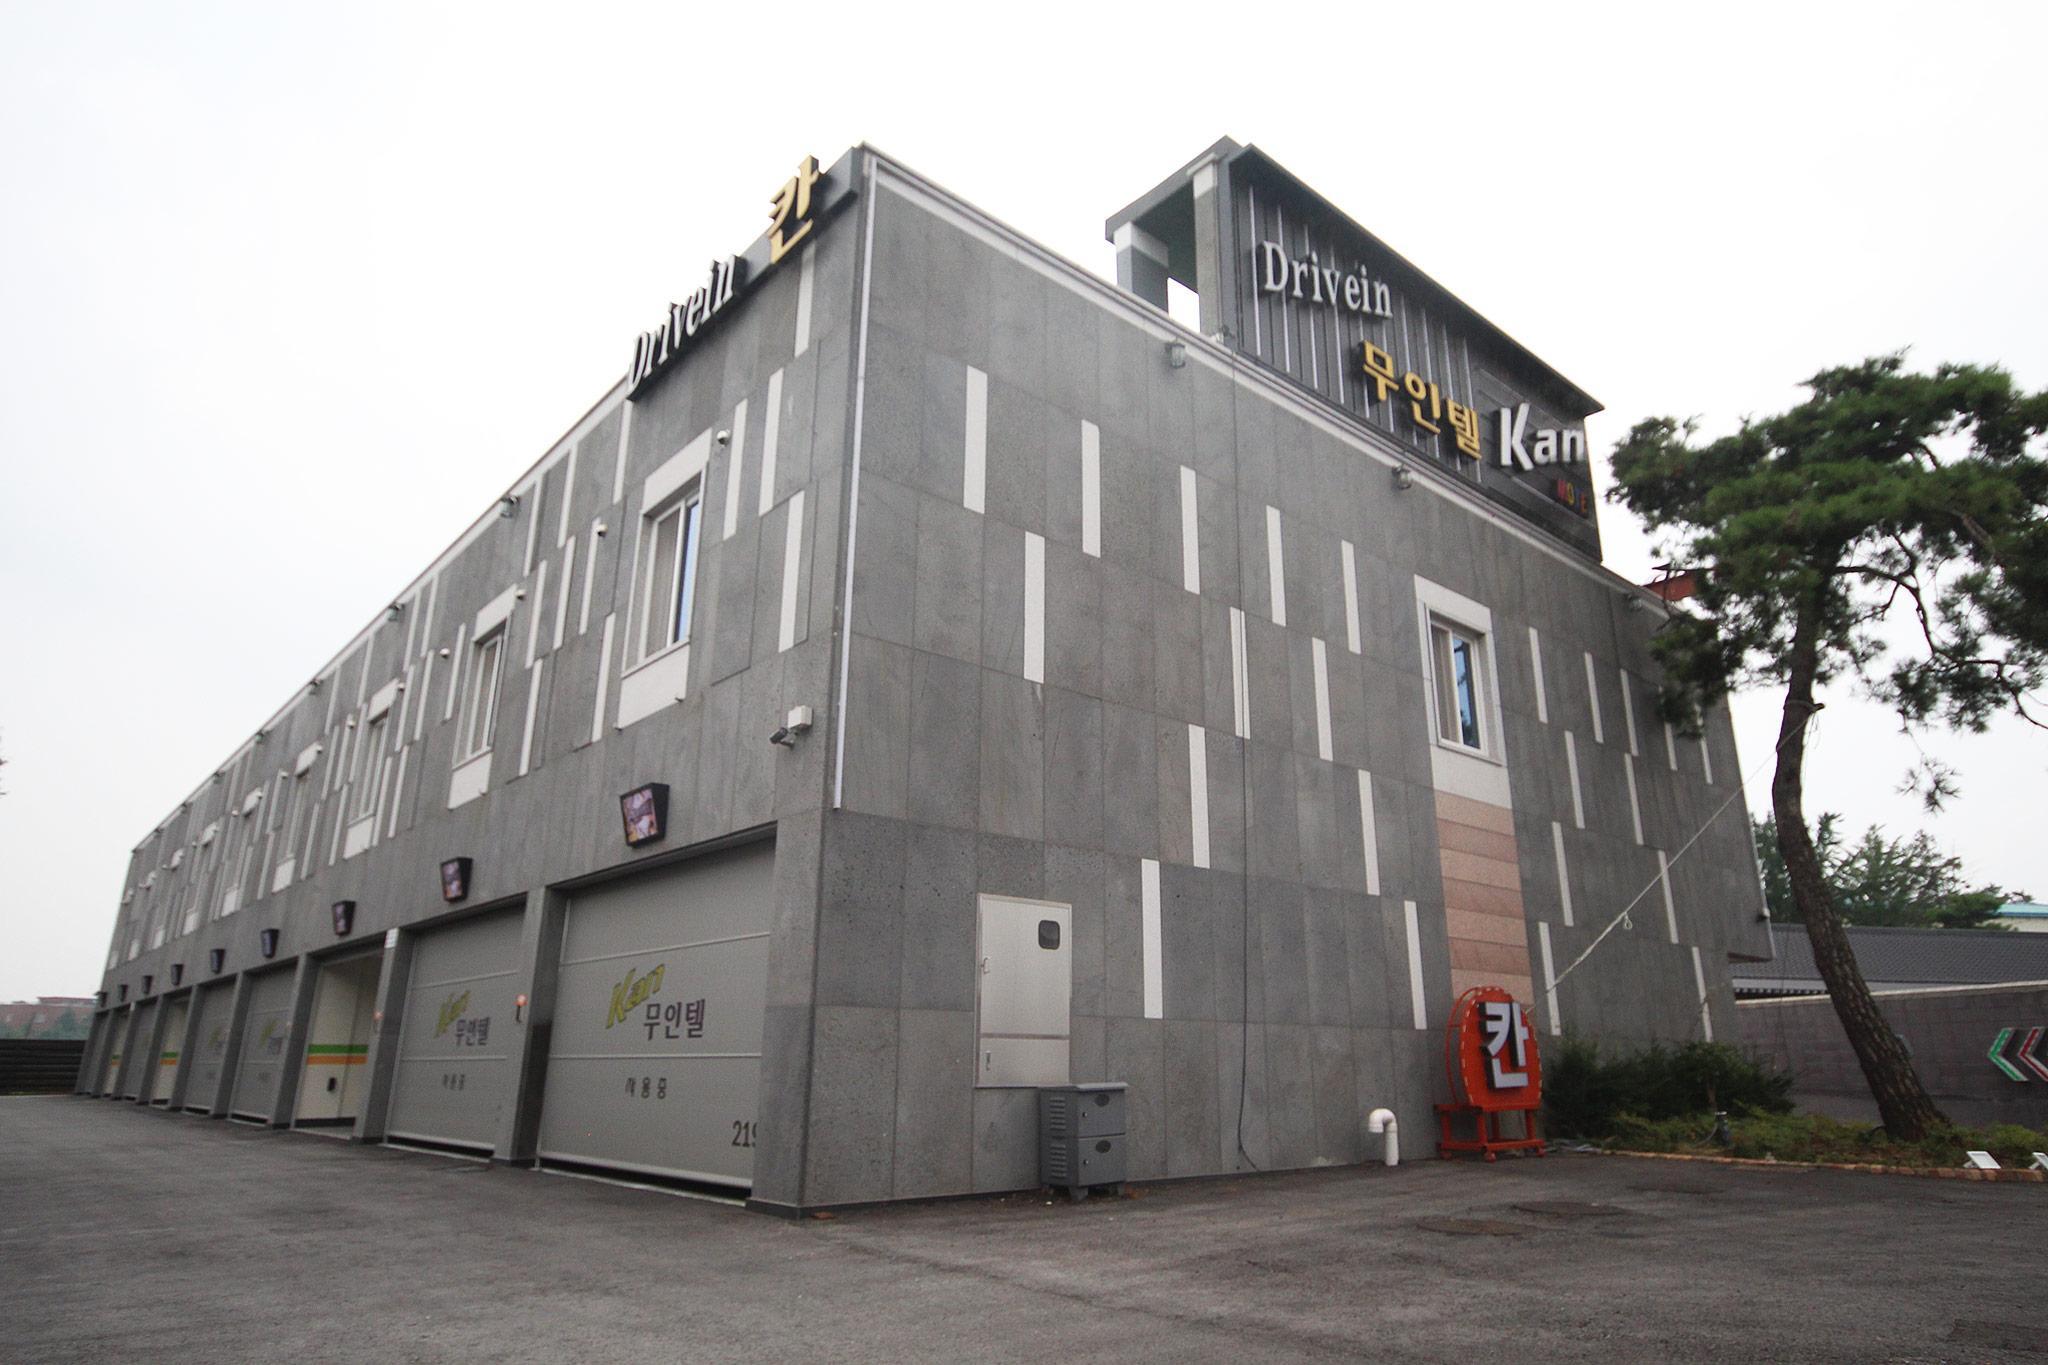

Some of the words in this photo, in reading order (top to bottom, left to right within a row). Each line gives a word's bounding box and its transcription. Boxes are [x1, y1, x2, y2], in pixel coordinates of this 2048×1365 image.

[767, 154, 820, 265] 칸
[1261, 240, 1393, 319] Drivein
[1362, 339, 1482, 460] 무인텔
[1496, 402, 1585, 472] Kan
[643, 998, 706, 1041] 무인텔
[1480, 1001, 1530, 1090] 칸
